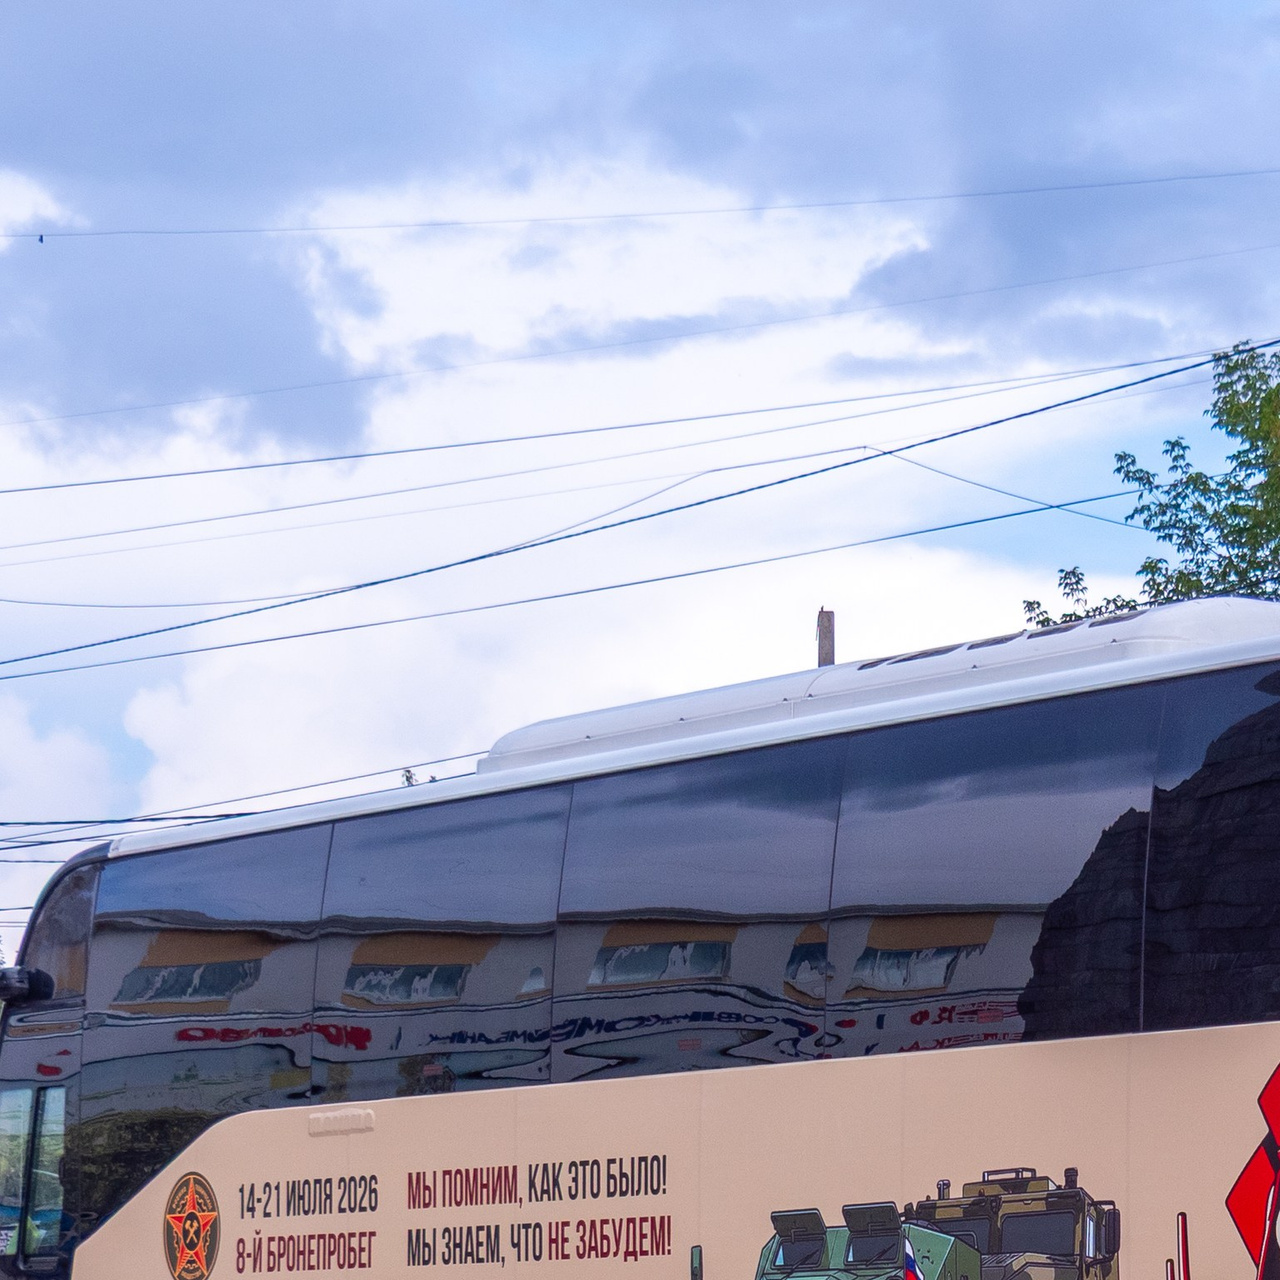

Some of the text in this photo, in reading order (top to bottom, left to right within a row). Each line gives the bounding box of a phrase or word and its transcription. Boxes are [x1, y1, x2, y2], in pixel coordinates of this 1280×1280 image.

[238, 1181, 281, 1219] 14-21
[286, 1177, 333, 1217] ИЮЛЯ
[337, 1174, 379, 1214] 2026
[407, 1154, 667, 1210] МЫ ПОМНИМ, КАК ЭТО БЫЛО!
[236, 1229, 377, 1274] 8-Й БРОНЕПРОБЕГ
[407, 1215, 672, 1269] МЫ ЗНАЕМ, ЧТО НЕ ЗАБУДЕМ!
